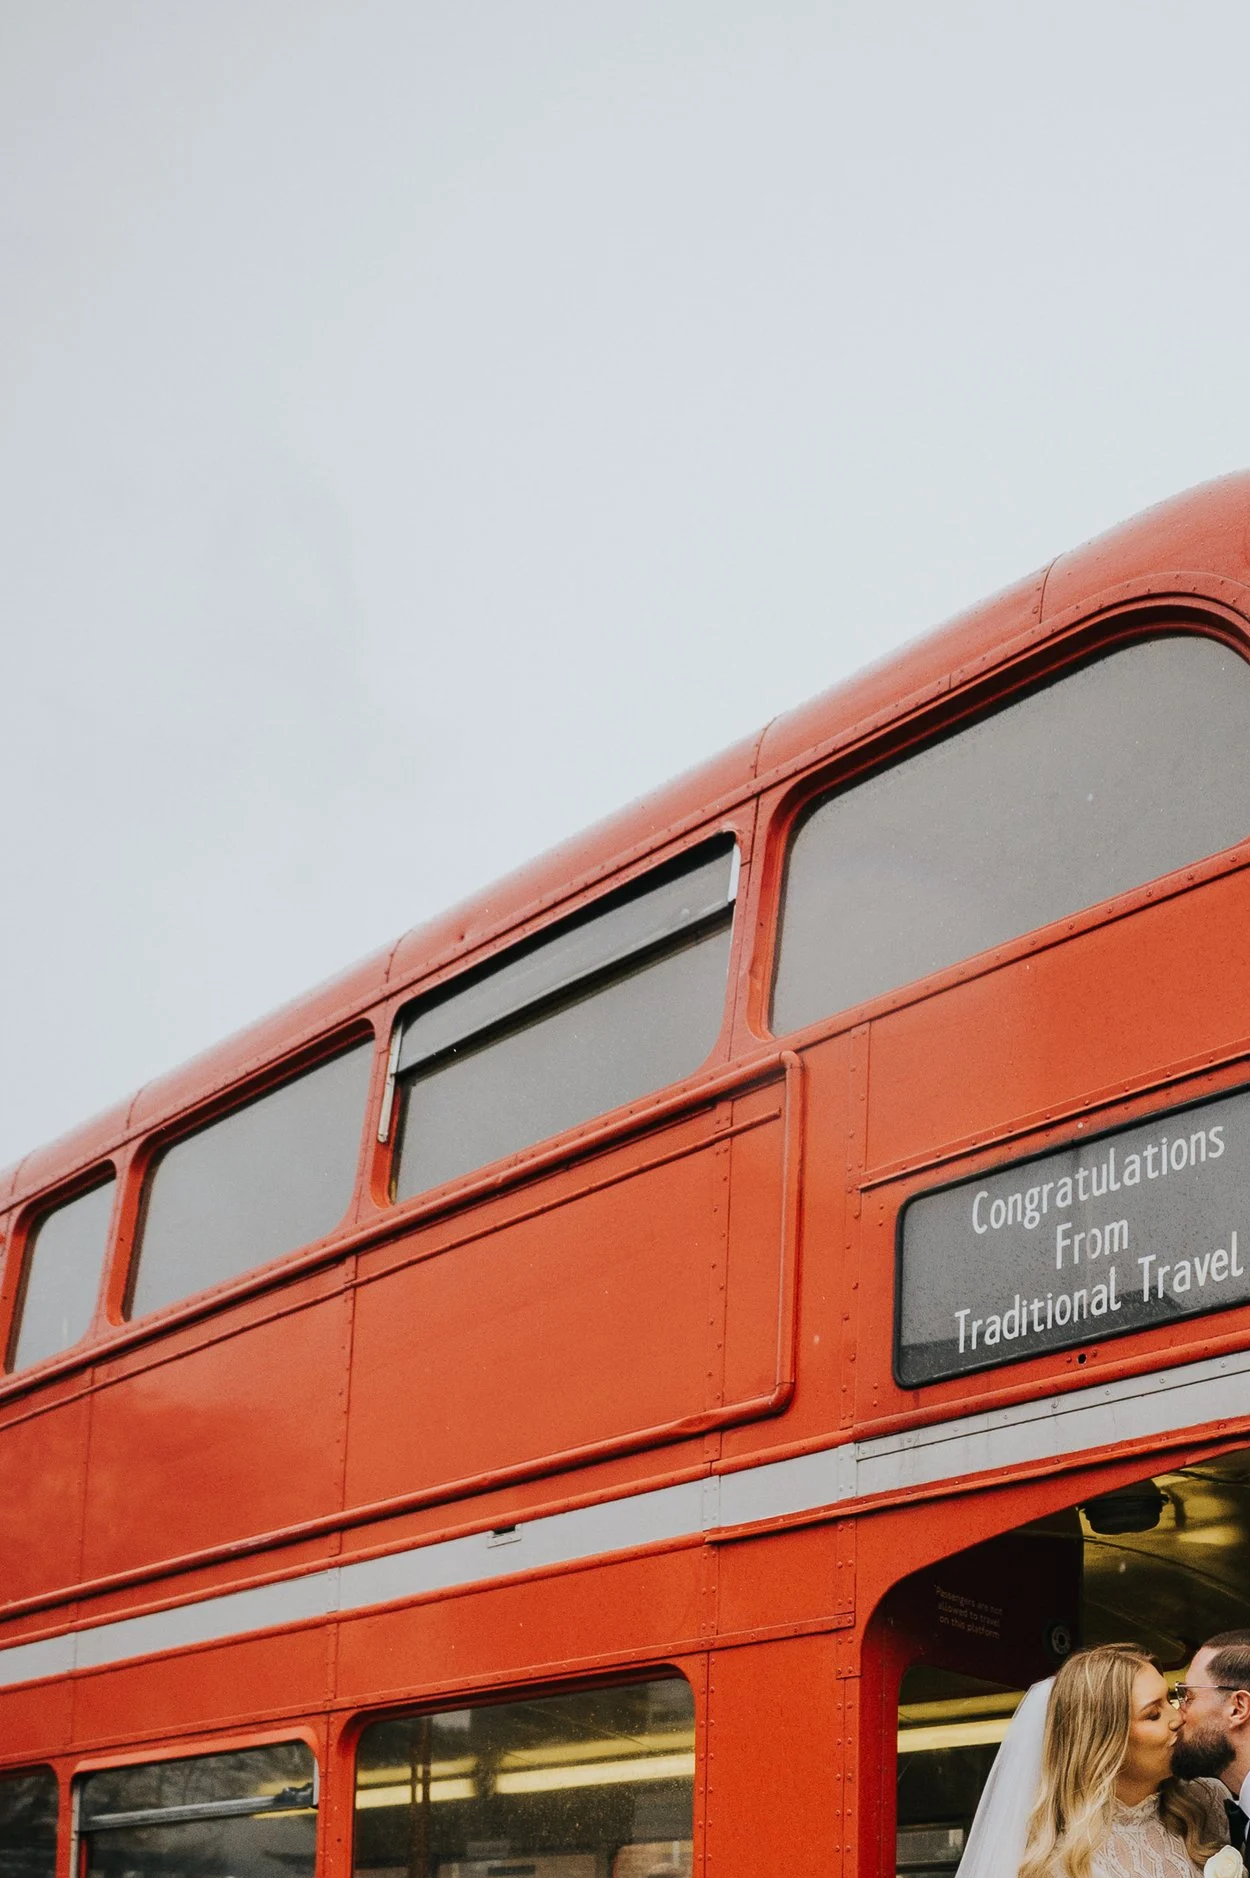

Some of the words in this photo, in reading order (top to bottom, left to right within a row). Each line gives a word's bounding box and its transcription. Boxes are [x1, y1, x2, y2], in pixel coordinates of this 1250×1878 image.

[972, 1126, 1225, 1234] Congratulations
[955, 1268, 1121, 1354] Traditional
[1138, 1231, 1244, 1303] Travel
[1056, 1218, 1129, 1270] From
